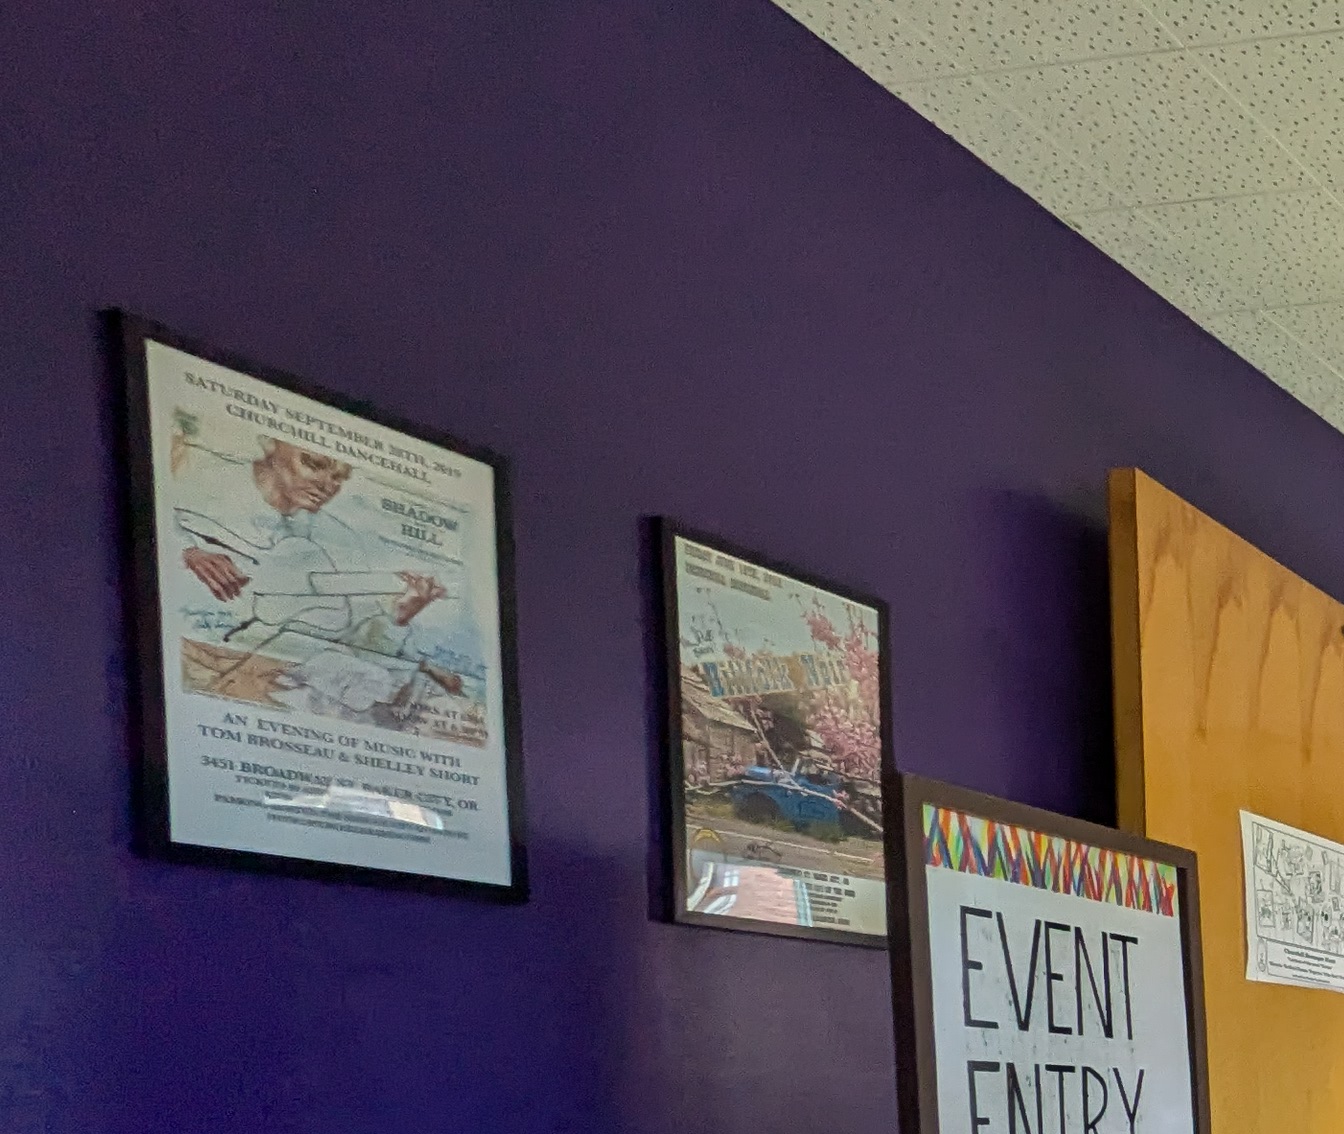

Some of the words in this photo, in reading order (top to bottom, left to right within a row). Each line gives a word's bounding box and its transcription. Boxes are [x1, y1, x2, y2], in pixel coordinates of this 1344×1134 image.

[185, 371, 279, 415] SATURDAY
[285, 408, 384, 452] SEPTEMBER
[226, 403, 332, 449] CHURCHILL
[335, 440, 432, 485] DANCEHALL
[381, 498, 459, 532] SHADOW
[401, 523, 444, 547] HILL
[197, 724, 242, 744] TOM
[247, 732, 335, 760] BROSSEAU
[337, 750, 350, 763] &
[354, 754, 426, 777] SHELLEY
[429, 767, 481, 786] SHORT
[223, 712, 249, 727] AN
[256, 719, 334, 744] EVENING
[338, 735, 361, 748] OF
[363, 740, 417, 760] MUSIC
[420, 750, 462, 769] WITH
[458, 799, 480, 811] OR
[959, 904, 1139, 1042] EVENT
